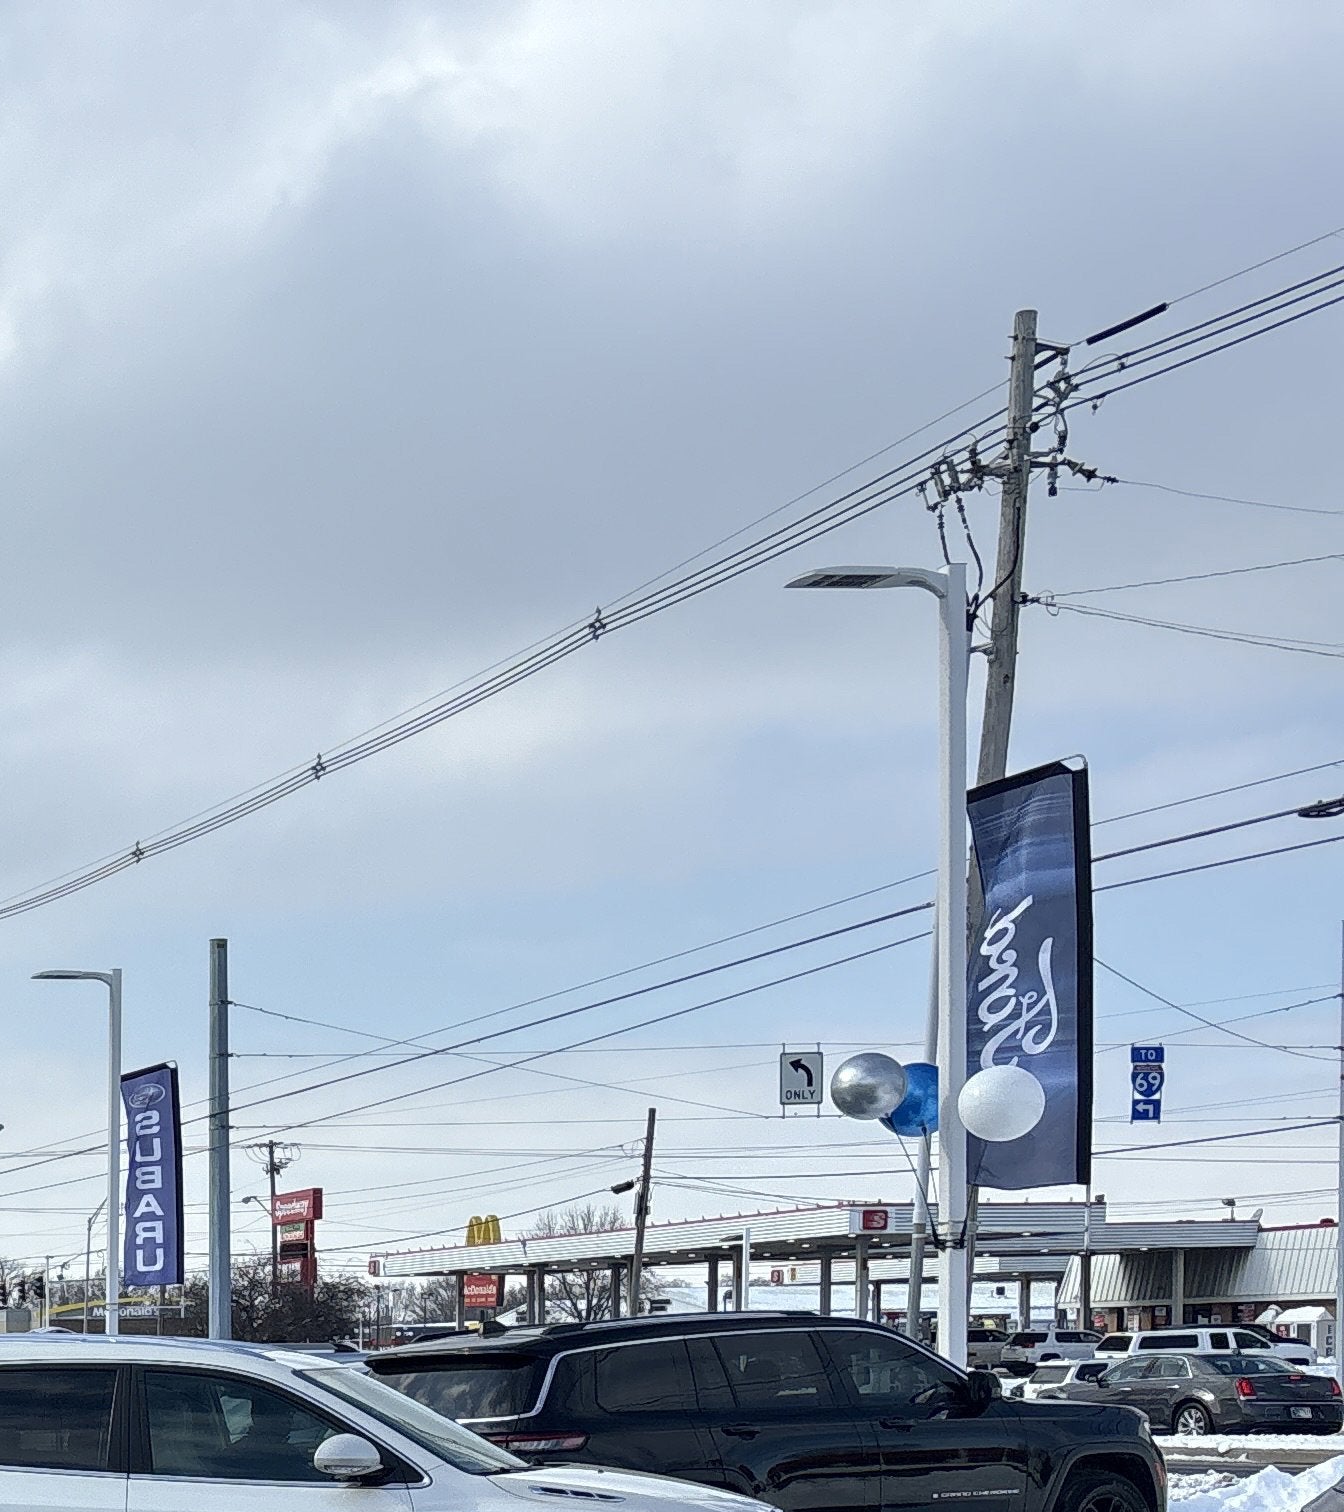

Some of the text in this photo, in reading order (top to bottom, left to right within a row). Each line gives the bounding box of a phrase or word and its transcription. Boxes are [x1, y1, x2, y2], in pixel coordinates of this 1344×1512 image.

[1140, 1050, 1156, 1060] TO
[1135, 1072, 1161, 1092] 69
[785, 1089, 816, 1100] ONLY
[92, 1304, 159, 1316] Monald's
